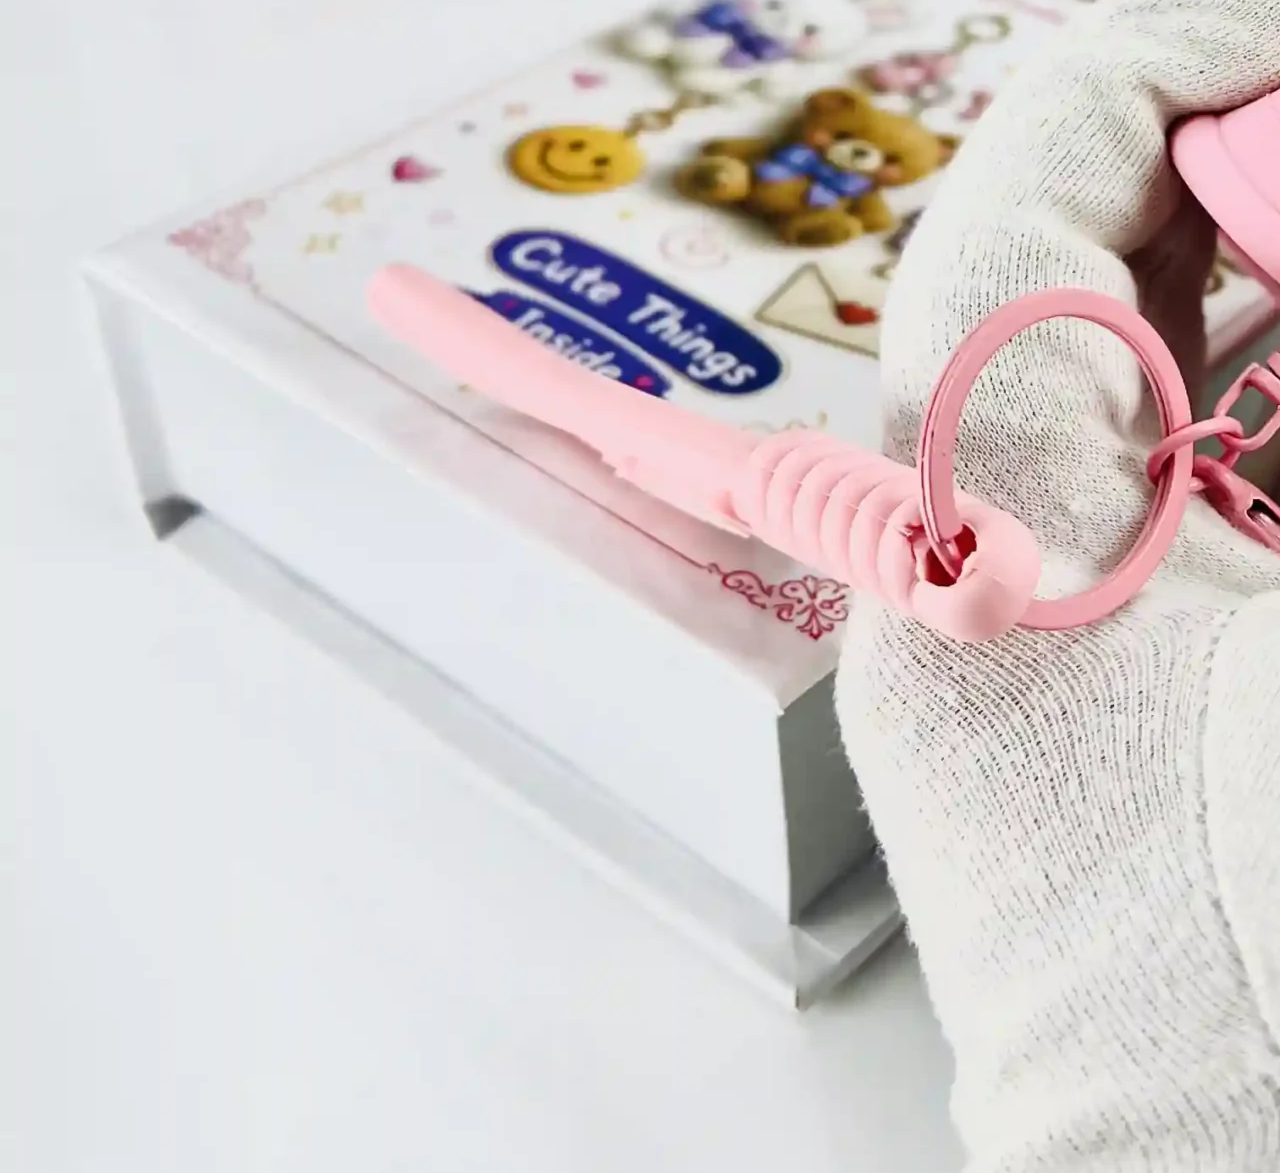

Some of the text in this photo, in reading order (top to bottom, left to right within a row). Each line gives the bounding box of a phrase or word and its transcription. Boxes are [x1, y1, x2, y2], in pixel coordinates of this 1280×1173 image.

[508, 237, 757, 387] Cute Things
[512, 307, 624, 379] Inside
